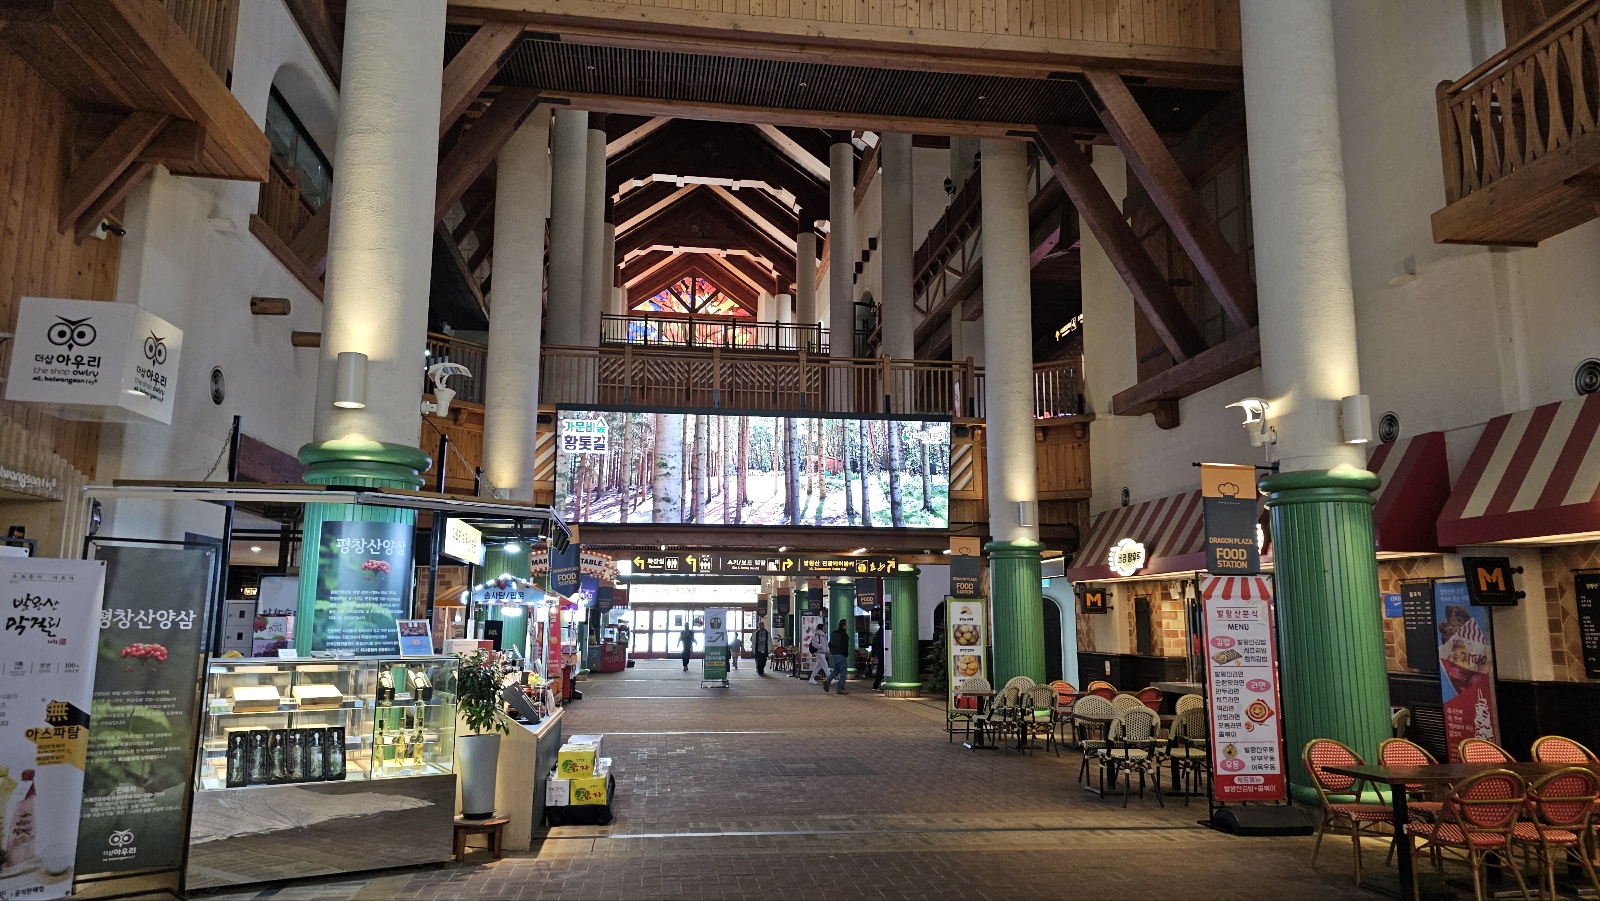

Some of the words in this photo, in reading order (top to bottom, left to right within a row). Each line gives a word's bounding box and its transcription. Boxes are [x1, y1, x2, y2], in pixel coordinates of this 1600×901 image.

[35, 354, 54, 365] 더샵
[56, 354, 101, 369] 아우리
[33, 367, 48, 375] the
[50, 368, 70, 376] shop
[72, 369, 99, 378] owlry
[146, 370, 167, 388] 아우리
[564, 418, 607, 433] 가문비숲
[564, 434, 606, 451] 황톳길
[1209, 536, 1234, 544] DRAGON
[336, 537, 406, 556] 평창산양삼
[1216, 547, 1248, 560] FOOD
[580, 558, 603, 567] TABLE
[1217, 560, 1248, 569] STATION
[557, 572, 577, 581] FOOD
[1477, 567, 1505, 591] M
[558, 579, 578, 587] STATION
[13, 593, 60, 612] 발왕산
[1086, 592, 1102, 607] M
[100, 608, 197, 630] 평창산양삼
[1216, 609, 1258, 619] 발왕산분식
[5, 615, 61, 637] 막걸리
[1227, 623, 1250, 631] MENU
[1217, 638, 1230, 647] 김밥
[1250, 681, 1266, 690] 라면
[45, 699, 69, 722] 無
[26, 726, 81, 741] 아스파탐
[1244, 746, 1275, 754] 발왕산우동
[1225, 761, 1239, 770] 우동
[1237, 776, 1261, 784] 세트메뉴
